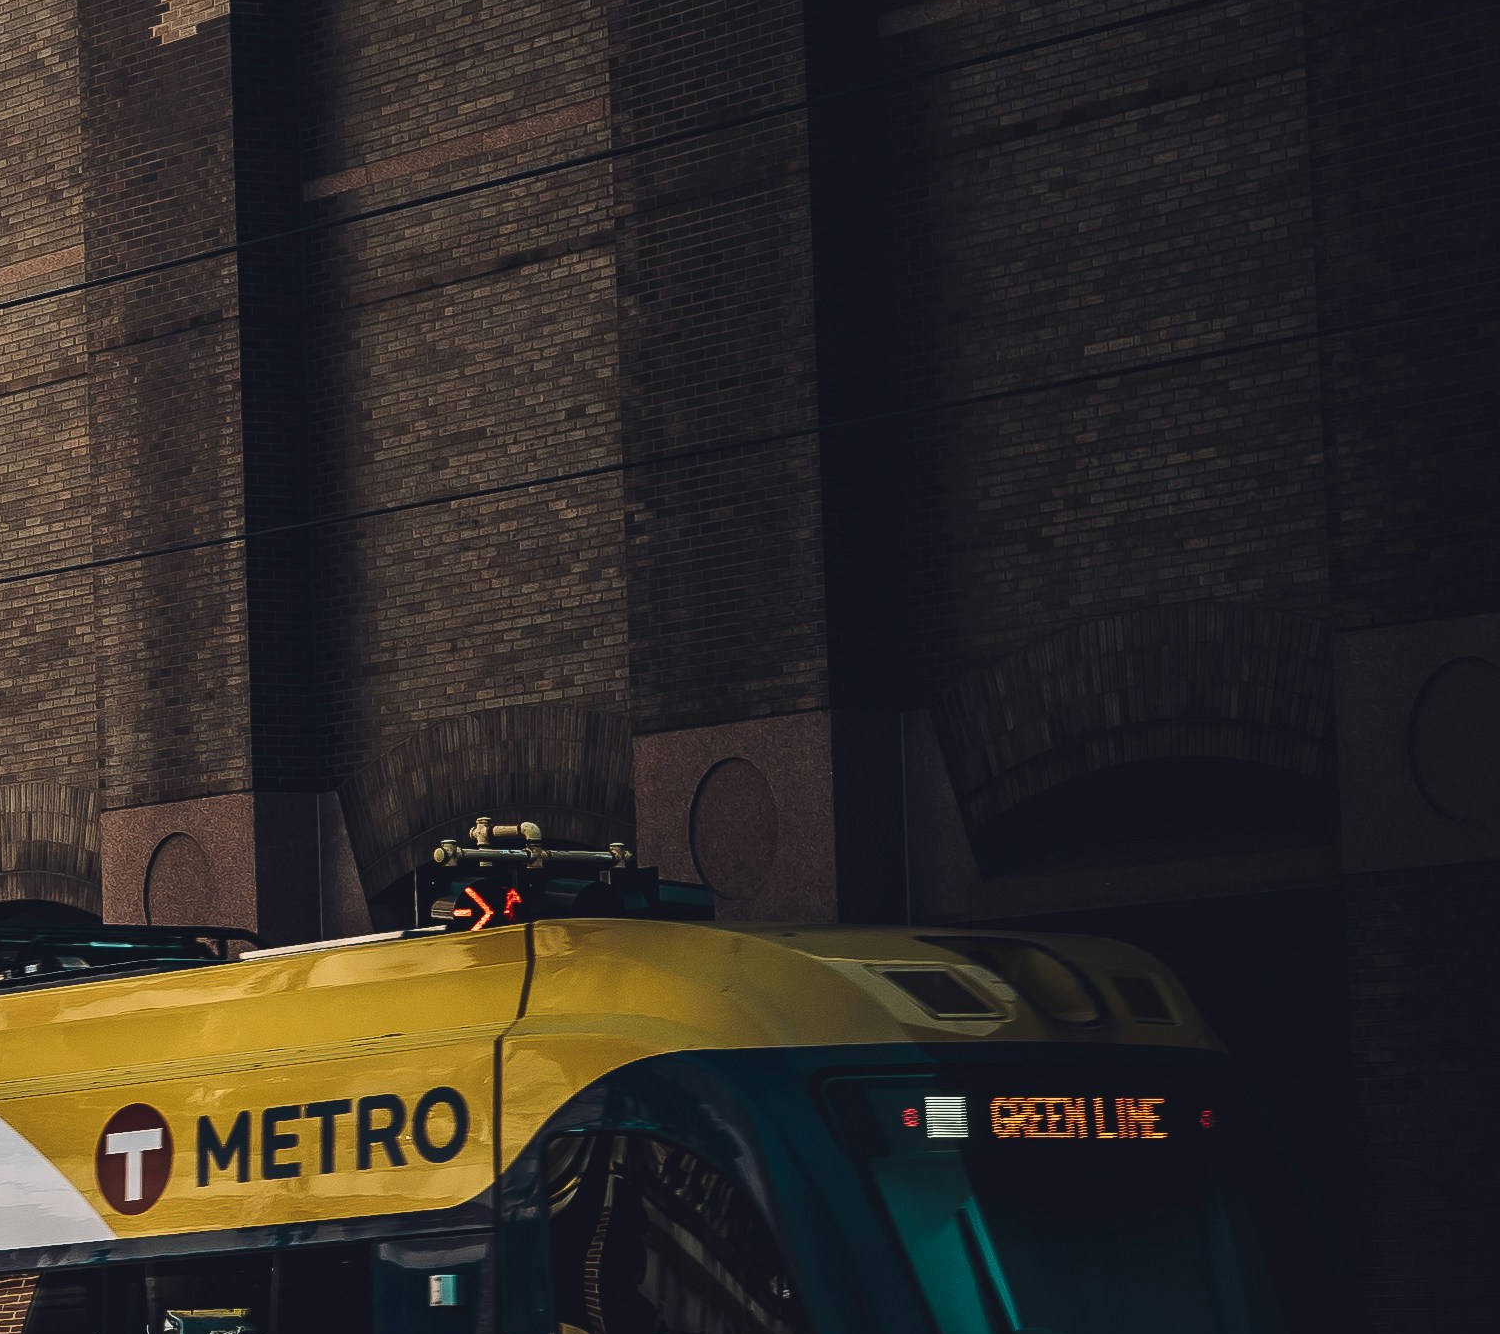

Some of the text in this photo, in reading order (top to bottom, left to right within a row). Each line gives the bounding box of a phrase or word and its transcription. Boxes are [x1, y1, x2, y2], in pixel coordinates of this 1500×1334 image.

[196, 1085, 470, 1187] METRO
[990, 1097, 1169, 1138] GREEN LINE
